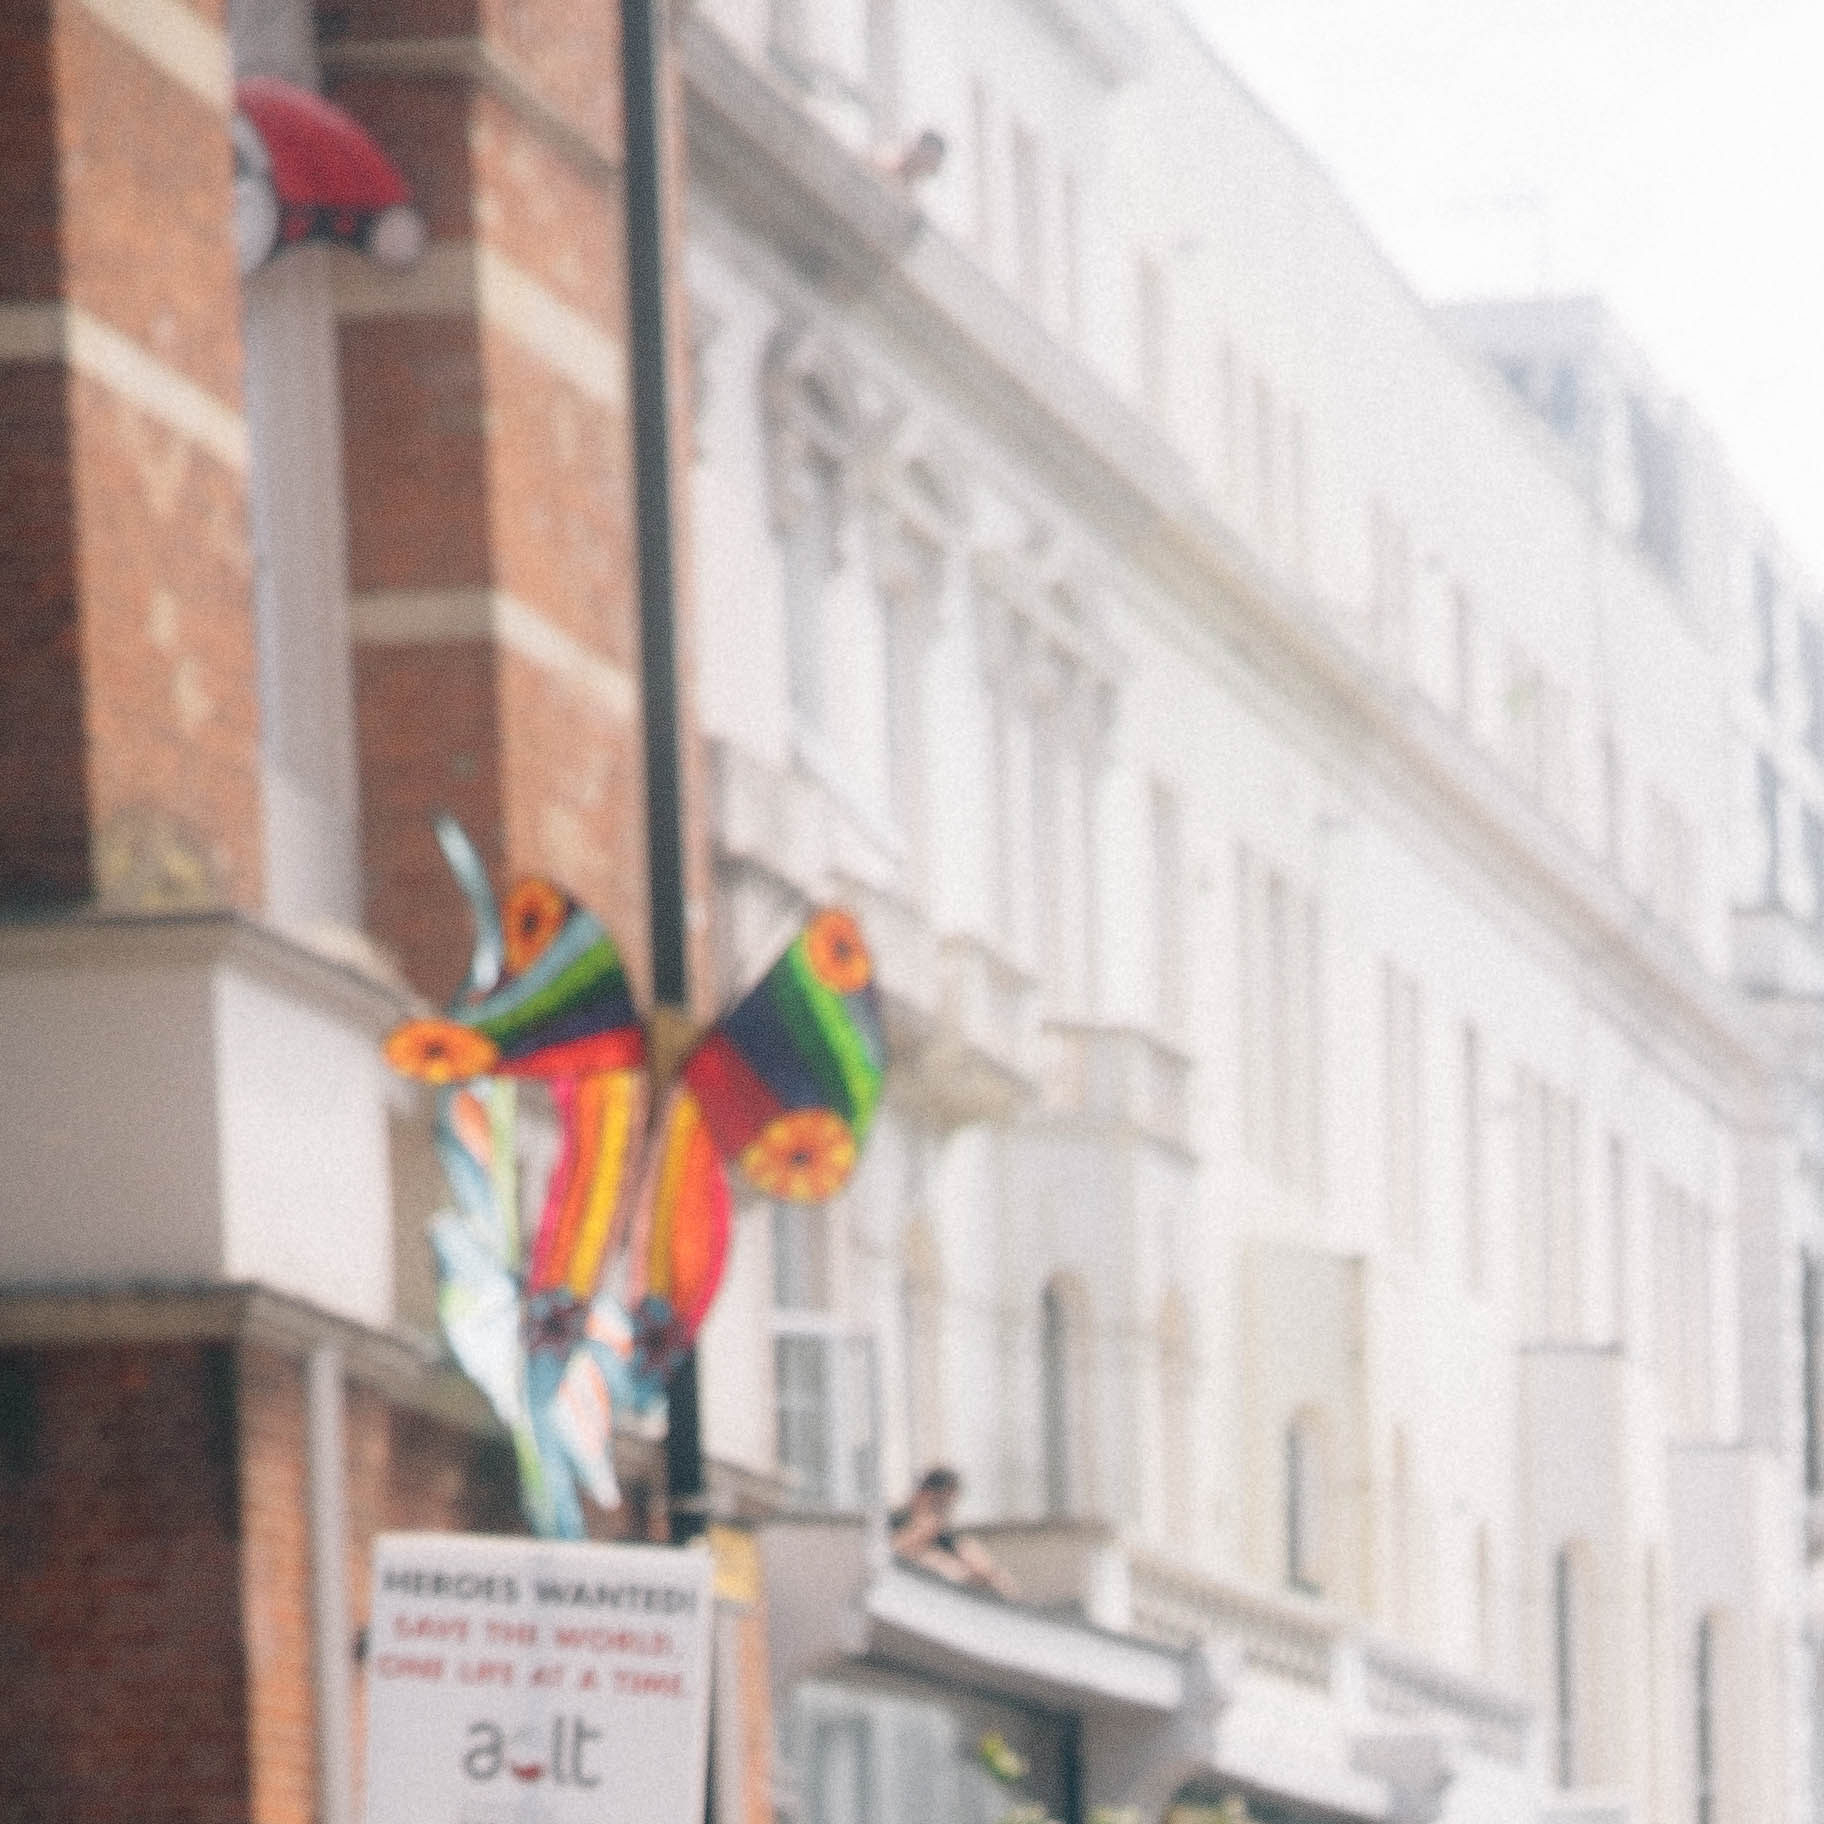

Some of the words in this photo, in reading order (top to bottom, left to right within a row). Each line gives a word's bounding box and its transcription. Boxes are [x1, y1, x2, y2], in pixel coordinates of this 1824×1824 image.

[382, 1569, 521, 1605] HEROES
[393, 1614, 469, 1643] SAVE
[486, 1619, 538, 1646] THE
[377, 1654, 445, 1684] ONE
[459, 1660, 514, 1688] LIFE
[528, 1664, 564, 1689] AT
[578, 1667, 600, 1692] A
